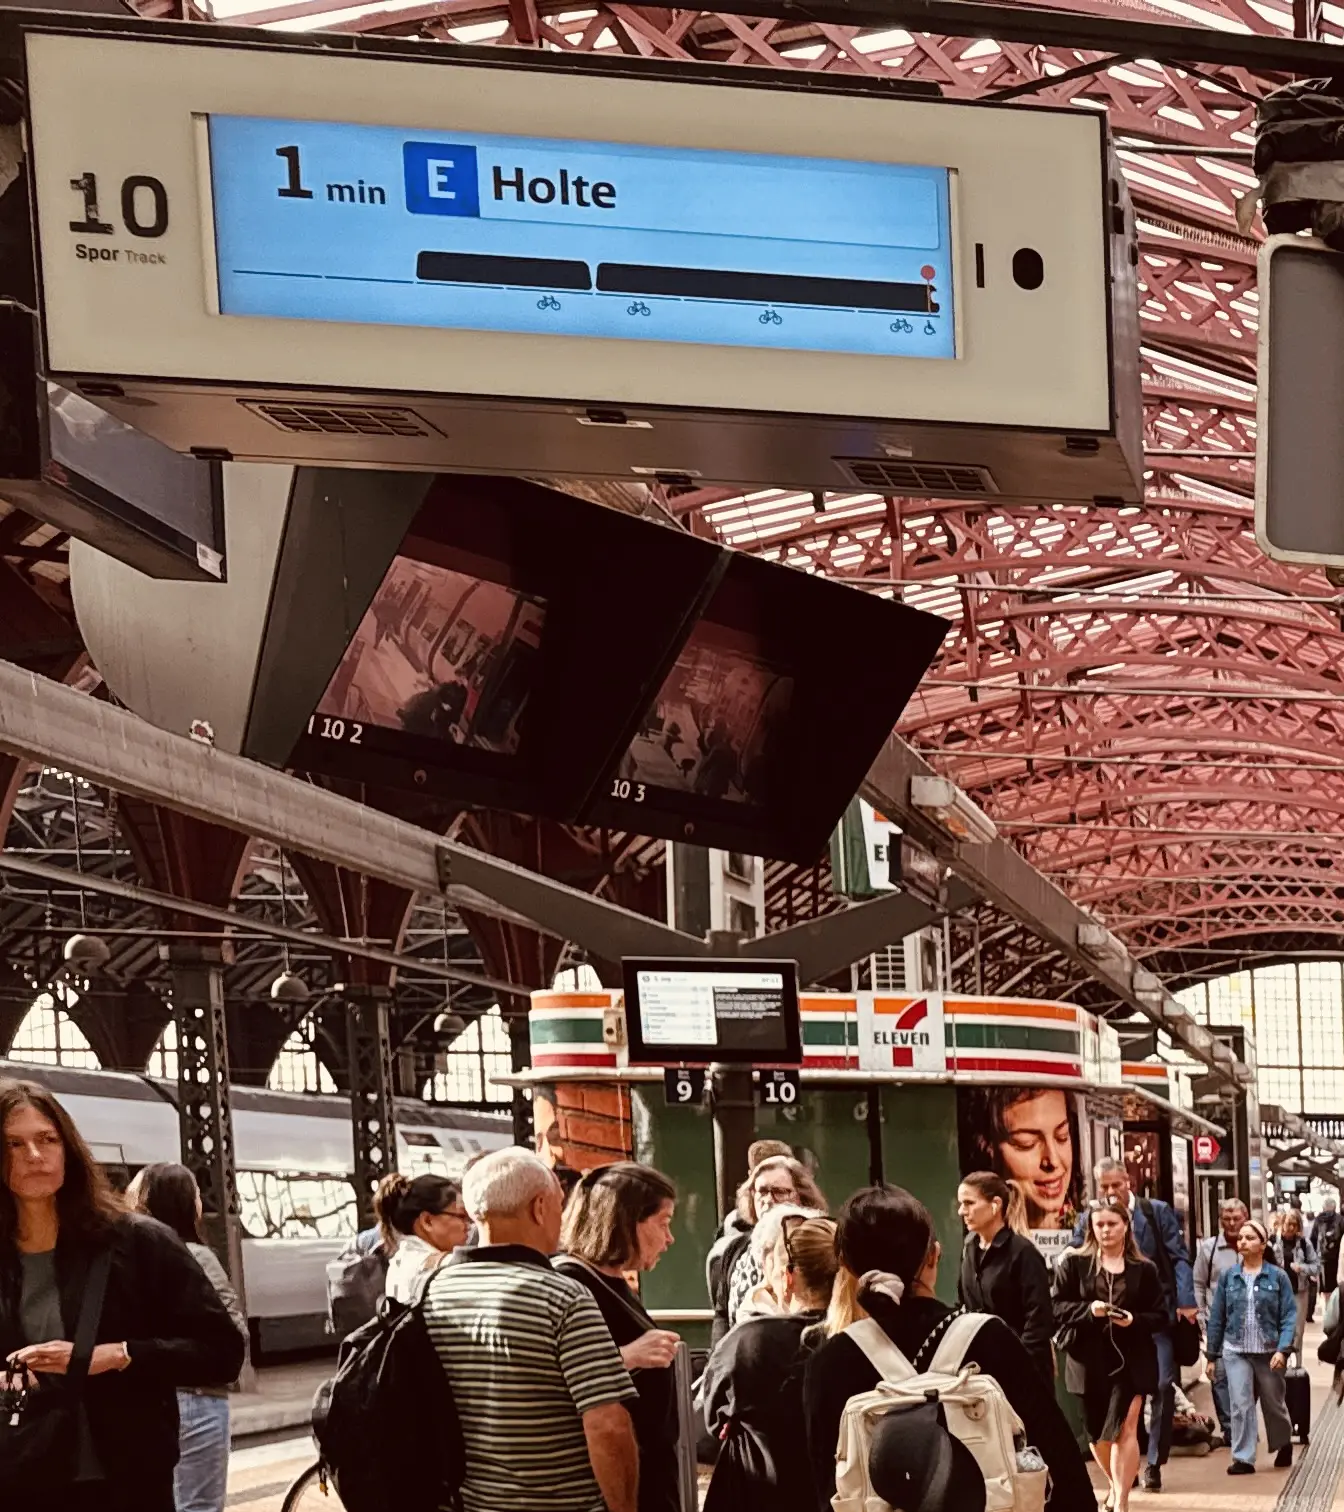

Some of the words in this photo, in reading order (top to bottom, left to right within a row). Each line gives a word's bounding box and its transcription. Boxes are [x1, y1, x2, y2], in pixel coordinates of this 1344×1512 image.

[275, 146, 313, 199] 1
[326, 179, 386, 205] min
[427, 158, 456, 199] E
[492, 165, 616, 209] Holte
[69, 172, 169, 238] 10
[75, 244, 120, 263] Spor
[124, 249, 167, 265] Track
[320, 717, 345, 740] 10
[349, 723, 363, 744] 2
[610, 779, 631, 799] 10
[634, 783, 646, 803] 3
[676, 1080, 693, 1102] 9
[765, 1081, 796, 1104] 10
